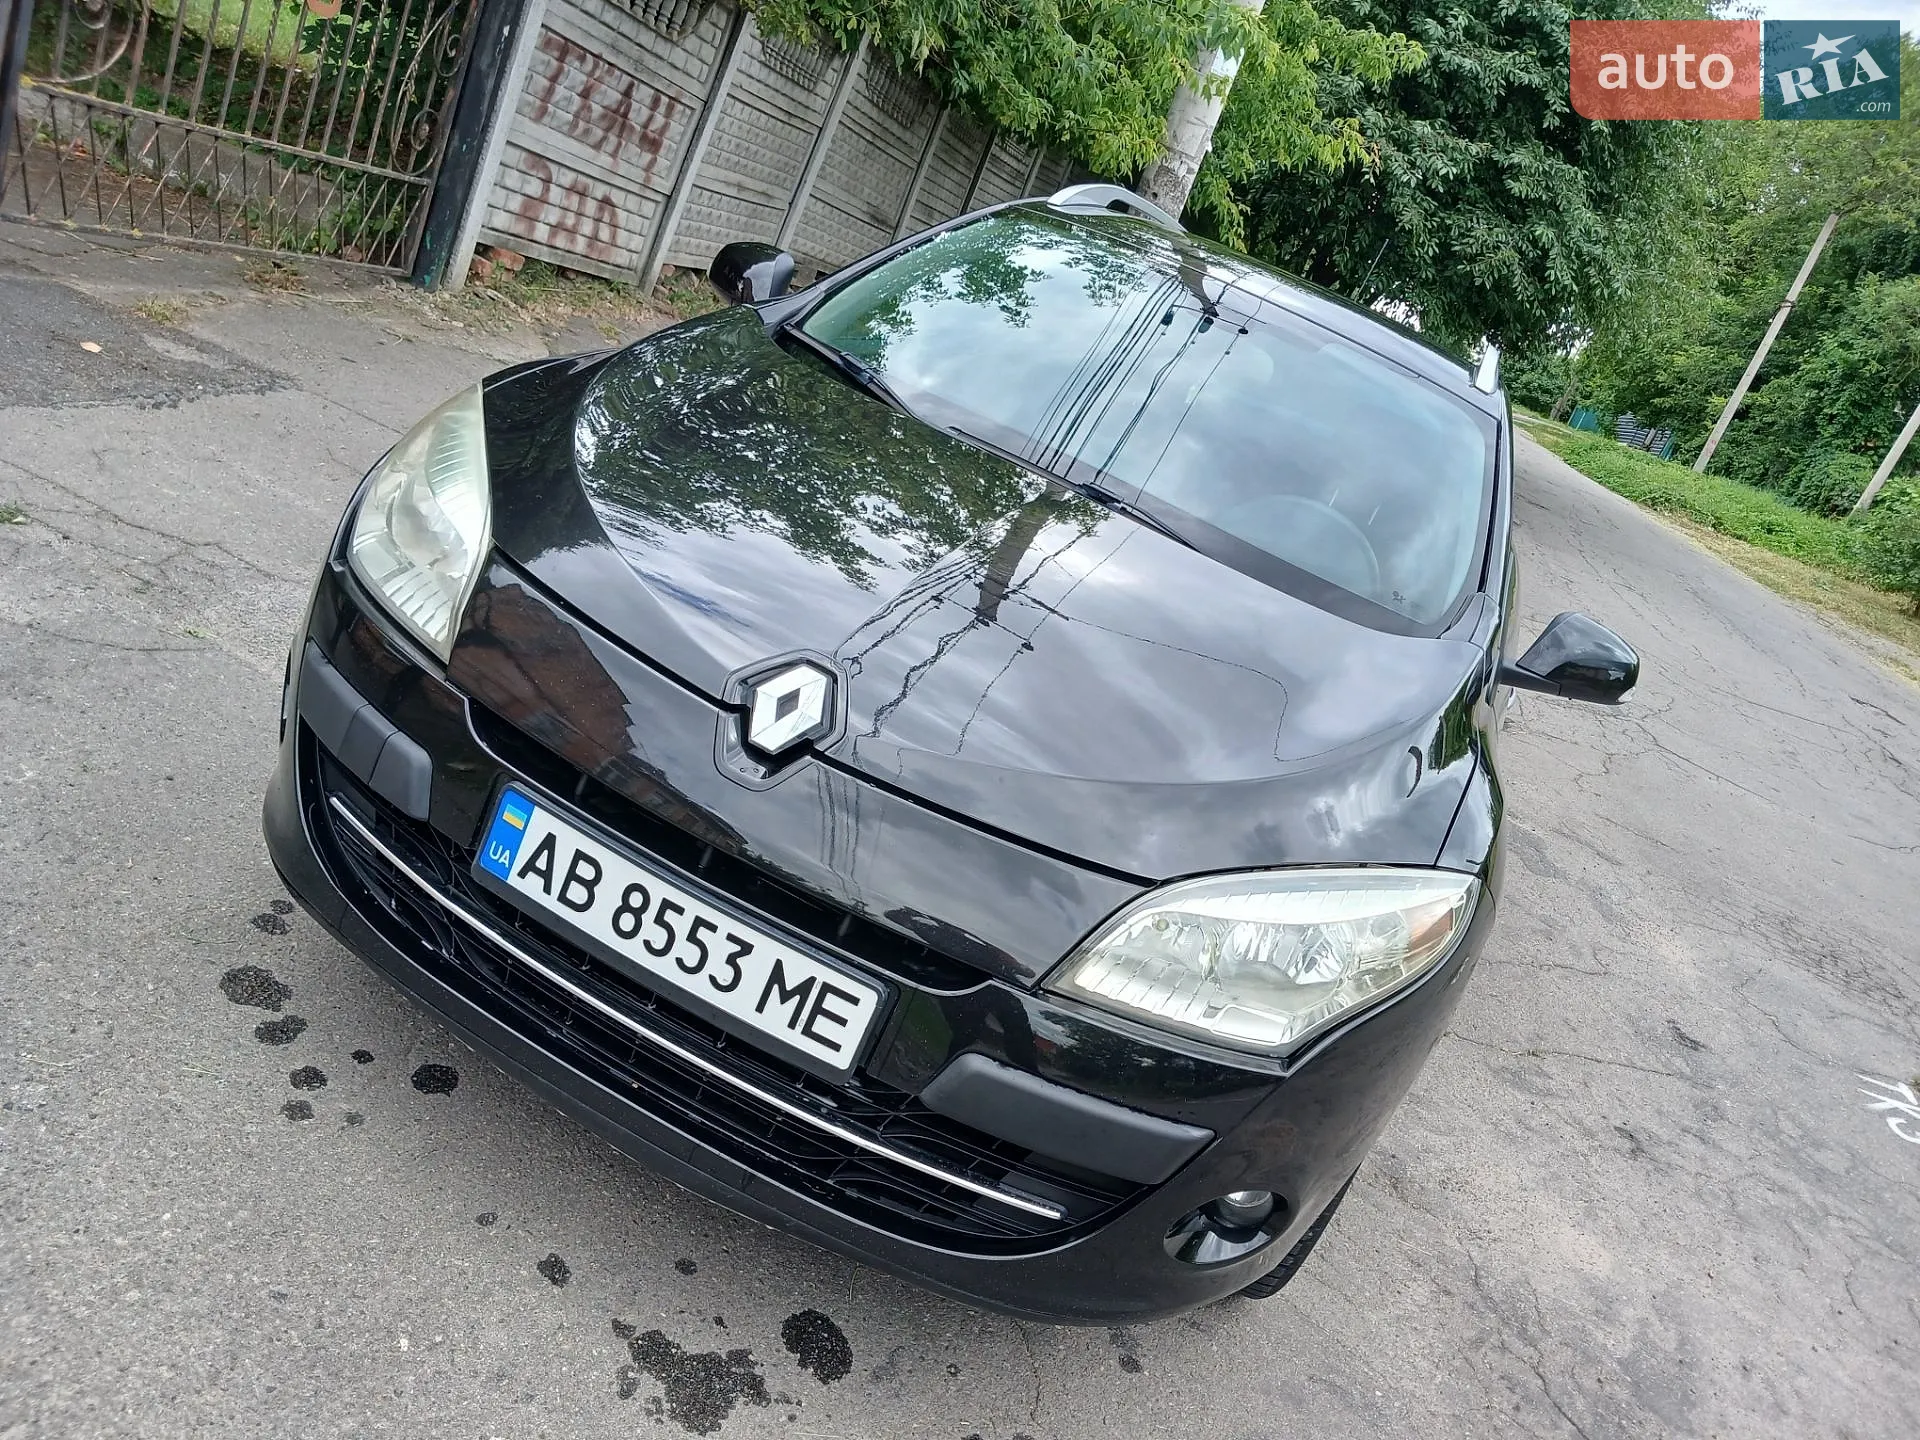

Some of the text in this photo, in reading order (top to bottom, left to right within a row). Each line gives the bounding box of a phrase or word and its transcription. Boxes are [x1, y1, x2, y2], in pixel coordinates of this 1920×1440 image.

[488, 840, 510, 869] UA
[517, 832, 860, 1052] AB 8553 ME
